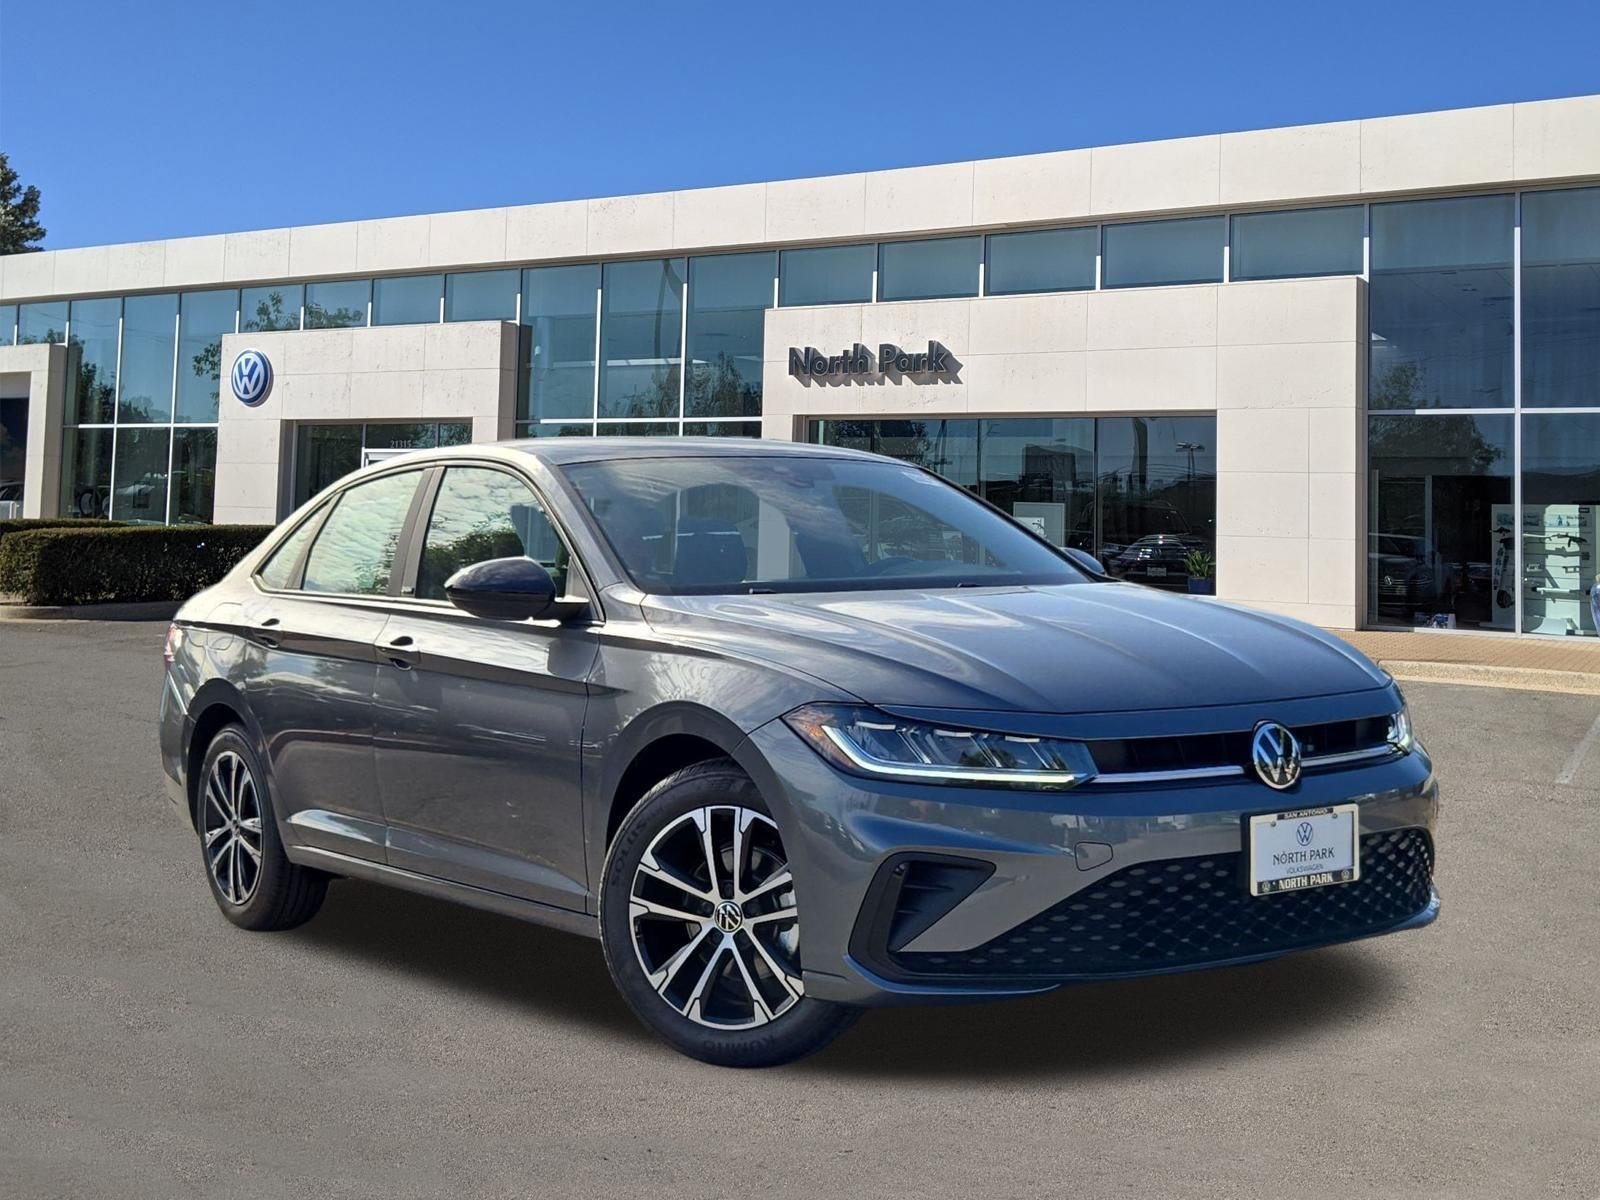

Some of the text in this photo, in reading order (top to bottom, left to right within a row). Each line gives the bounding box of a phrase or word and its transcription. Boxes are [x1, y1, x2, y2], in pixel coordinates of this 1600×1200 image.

[789, 340, 949, 376] North Park
[1284, 811, 1298, 819] SAN
[1273, 847, 1335, 865] NORTH PARK
[1279, 876, 1308, 890] NORTH
[1310, 873, 1334, 885] PARK
